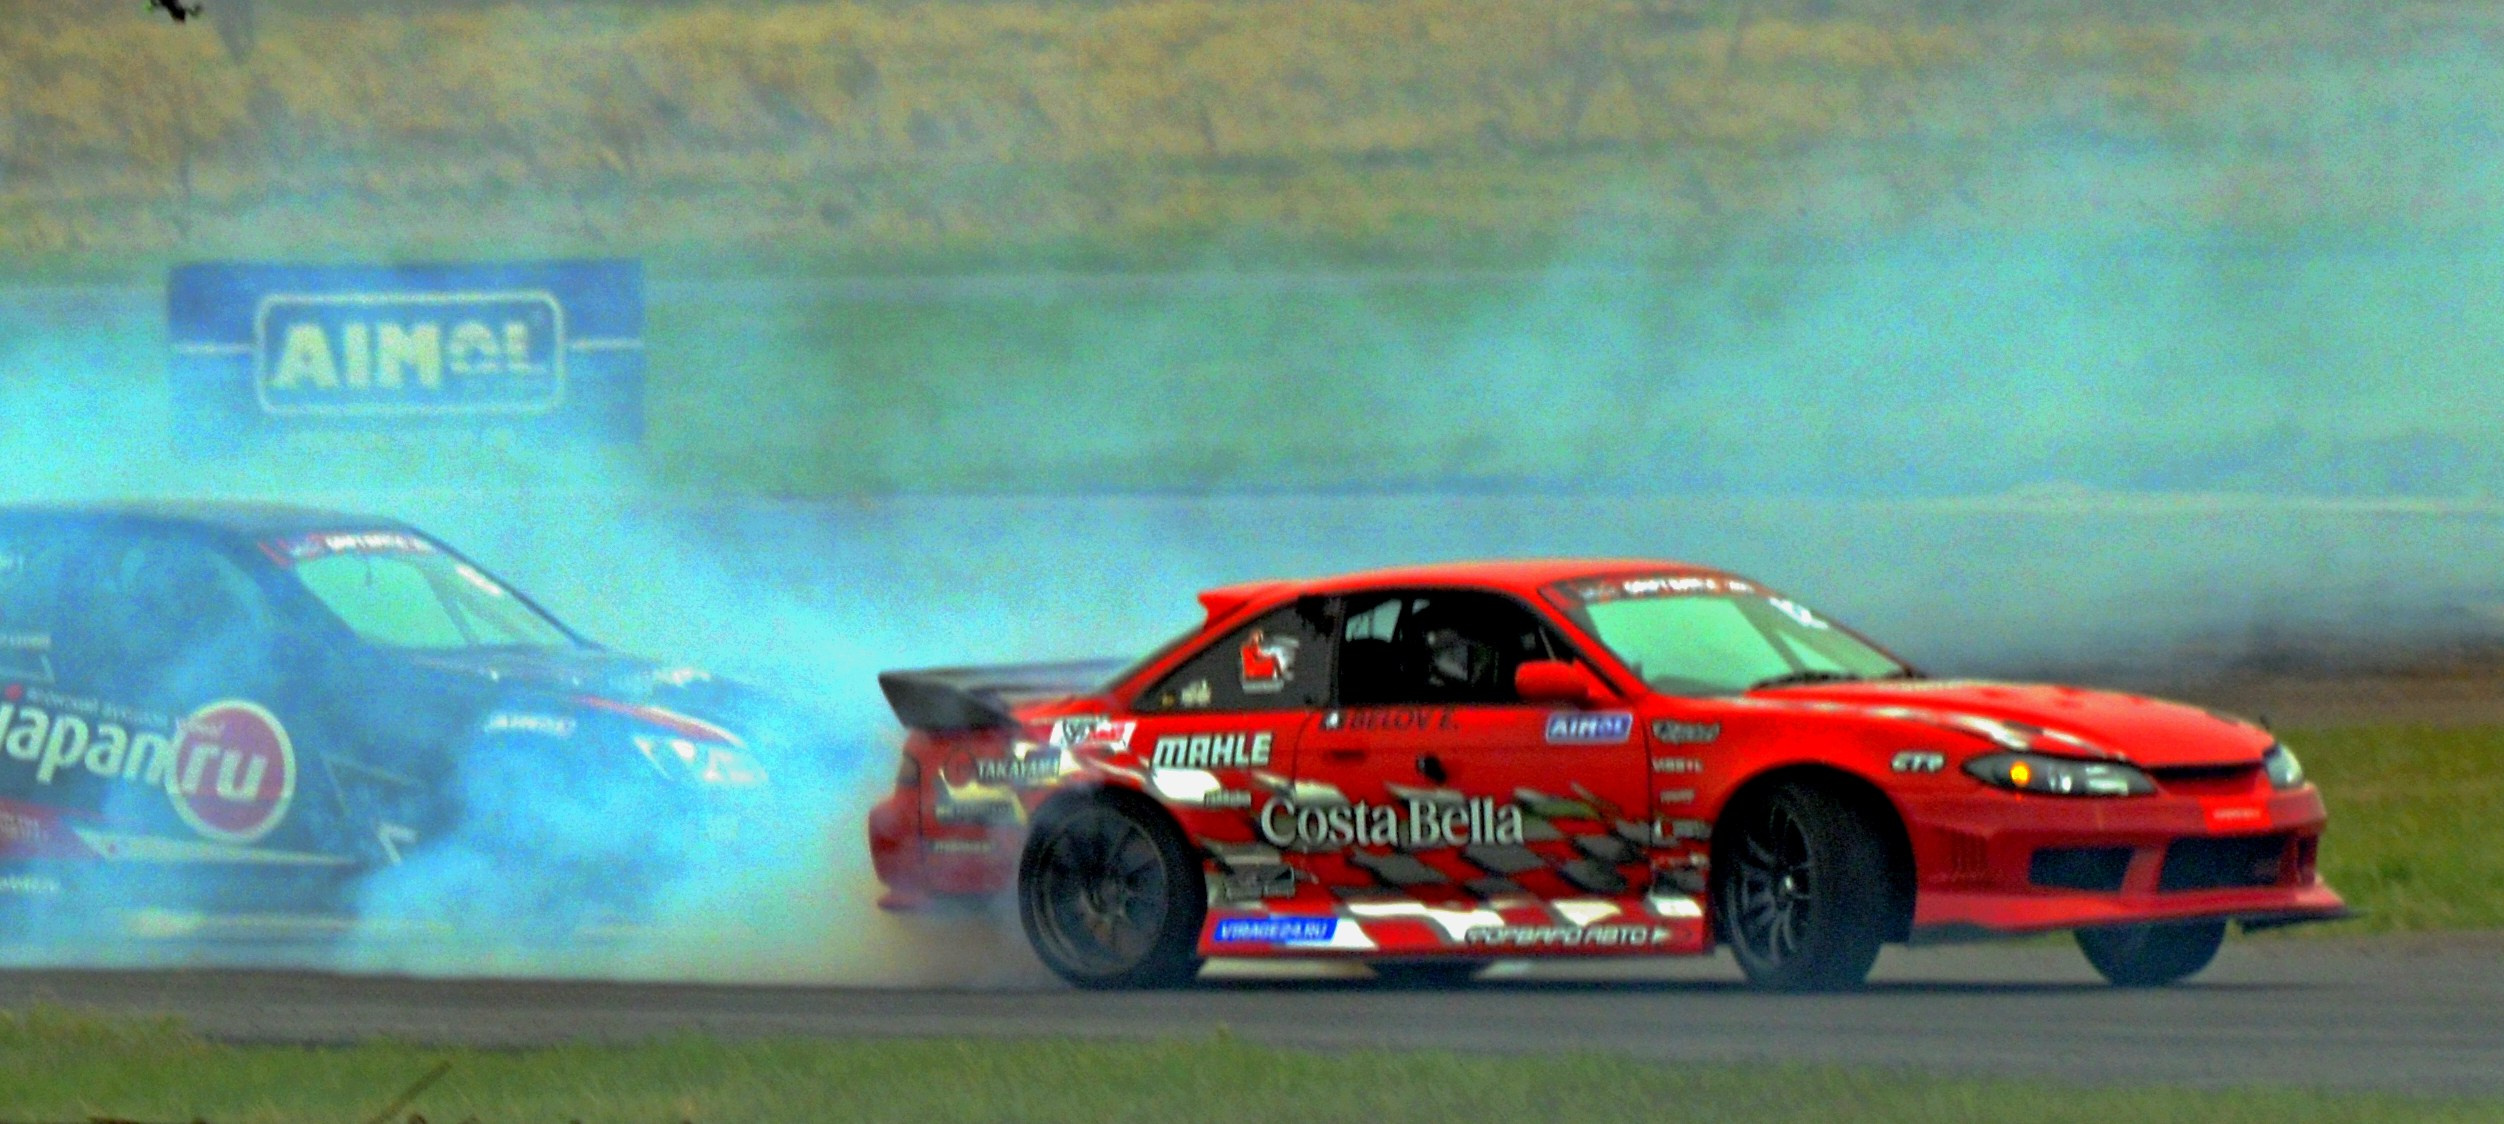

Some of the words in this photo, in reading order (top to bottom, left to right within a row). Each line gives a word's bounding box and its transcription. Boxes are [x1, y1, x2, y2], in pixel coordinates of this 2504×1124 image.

[268, 320, 548, 390] AIMOL
[1152, 731, 1274, 769] MAHLE
[1260, 797, 1399, 848] Costa
[1408, 795, 1525, 847] Bella
